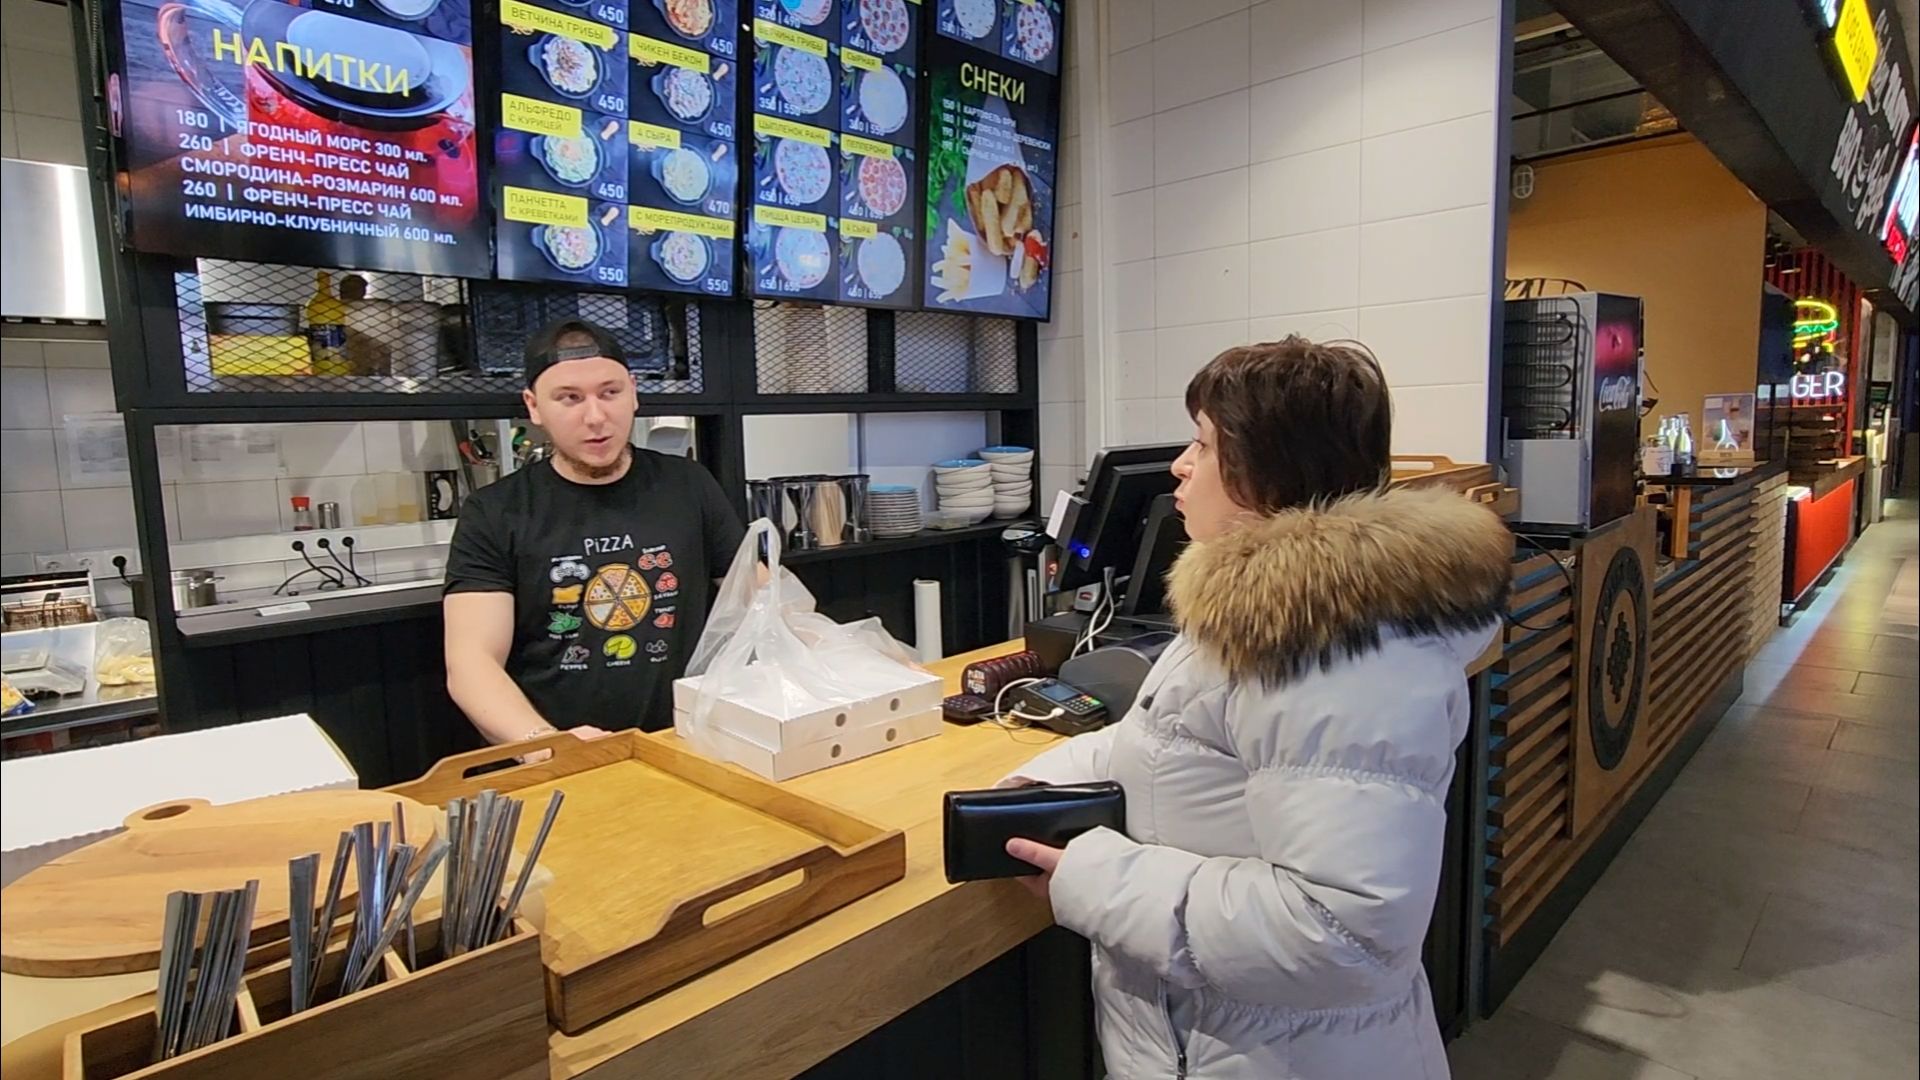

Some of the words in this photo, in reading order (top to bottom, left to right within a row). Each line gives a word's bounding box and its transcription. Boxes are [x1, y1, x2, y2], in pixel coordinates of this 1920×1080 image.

[510, 4, 563, 32] ВЕТЧИНА
[566, 20, 604, 41] ГРИБЫ
[598, 4, 625, 24] 450
[636, 41, 671, 59] ЧИКЕН
[672, 50, 703, 67] БЕКОН
[710, 37, 734, 55] 450
[212, 28, 411, 98] НАПИТКИ
[960, 61, 1026, 105] СНЕКИ
[508, 100, 573, 121] АЛЬФРЕДО
[598, 93, 625, 112] 450
[509, 113, 518, 124] С
[520, 115, 563, 133] КУРИЦЕЙ
[709, 121, 733, 138] 450
[175, 109, 209, 129] 180
[235, 119, 322, 146] ЯГОДНЫЙ
[326, 134, 372, 154] МОРС
[374, 141, 402, 158] 300
[405, 149, 428, 163] мл.
[644, 129, 673, 143] СЫРА
[178, 133, 213, 152] 260
[240, 144, 372, 175] ФРЕНЧ-ПРЕСС
[375, 160, 410, 180] ЧАЙ
[181, 157, 407, 200] СМОРОДИНА-РОЗМАРИН
[409, 187, 436, 204] 600
[439, 194, 463, 208] мл.
[598, 182, 625, 200] 450
[182, 179, 217, 198] 260
[243, 187, 374, 217] ФРЕНЧ-ПРЕСС
[377, 201, 412, 220] ЧАЙ
[509, 193, 567, 210] ПАНЧЕТТА
[708, 199, 730, 214] 470
[185, 203, 400, 239] ИМБИРНО-КЛУБНИЧНЫЙ
[403, 226, 430, 243] 600
[434, 233, 458, 246] мл.
[509, 205, 518, 216] С
[520, 206, 579, 224] КРЕВЕТКАМИ
[635, 210, 643, 221] С
[644, 211, 730, 232] МОРЕПРОДУКТАМИ
[598, 266, 625, 284] 550
[707, 278, 729, 294] 550
[1791, 371, 1845, 398] GER
